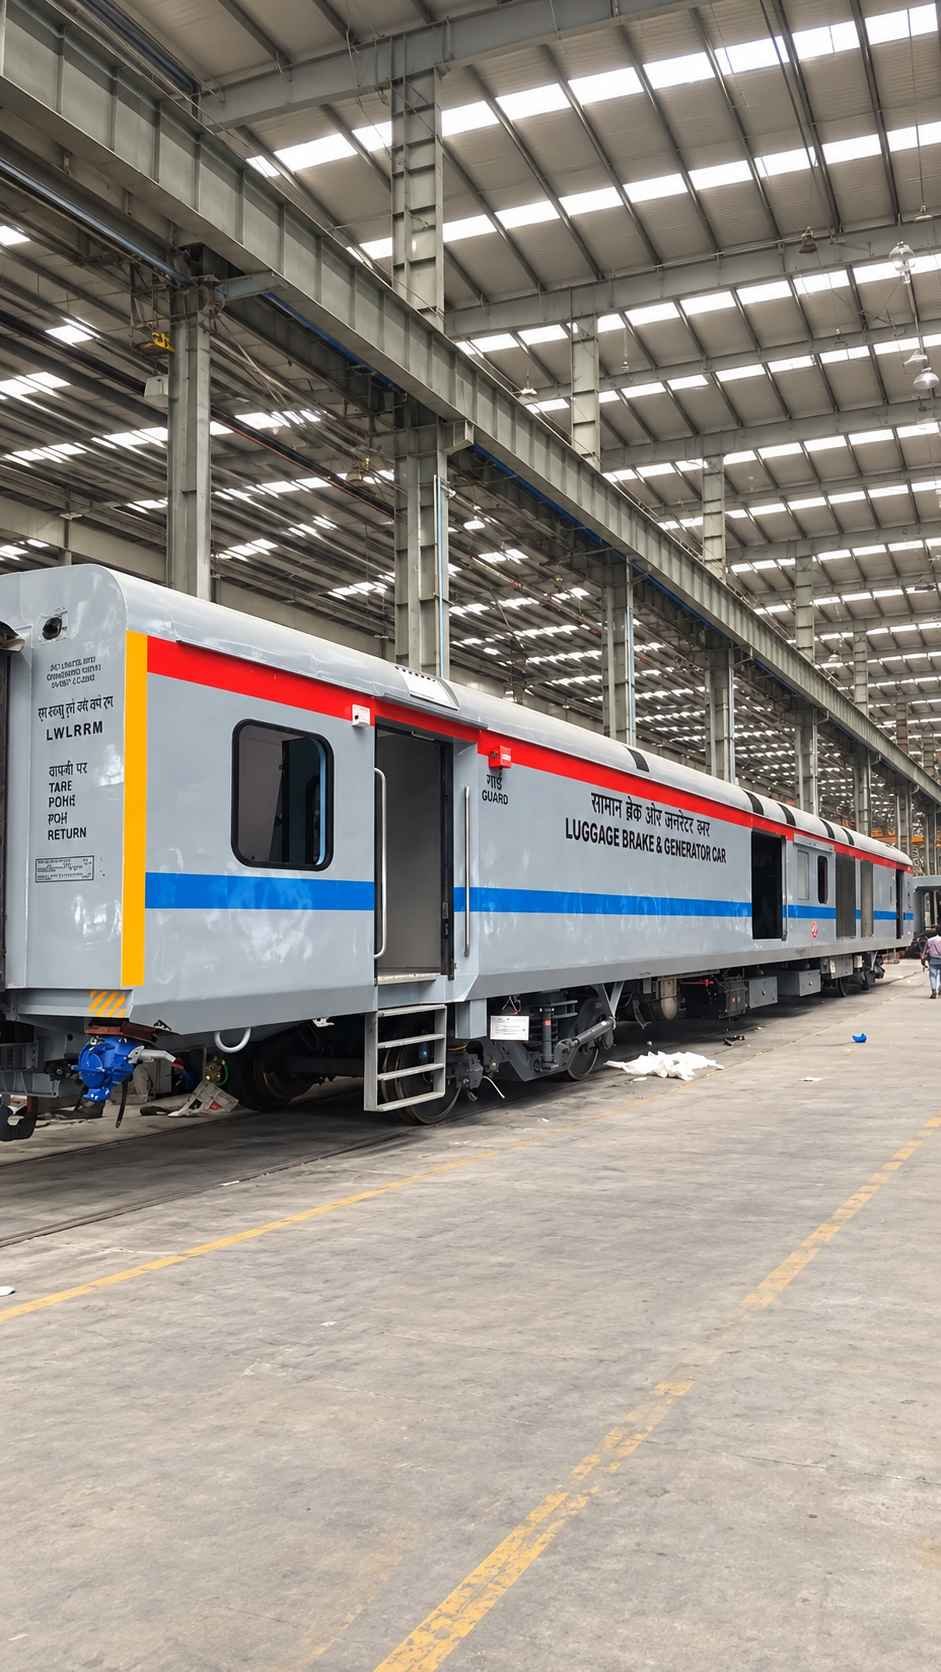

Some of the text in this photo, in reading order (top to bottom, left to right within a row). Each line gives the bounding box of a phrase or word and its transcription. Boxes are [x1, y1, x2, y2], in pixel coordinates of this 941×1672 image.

[46, 720, 103, 741] LWLRRM
[48, 780, 73, 793] TARE
[481, 789, 509, 805] GUARD
[590, 792, 623, 819] सामान
[47, 827, 87, 841] RETURN
[565, 817, 727, 864] LUGGAGE BRAKE & GENERATOR CAR
